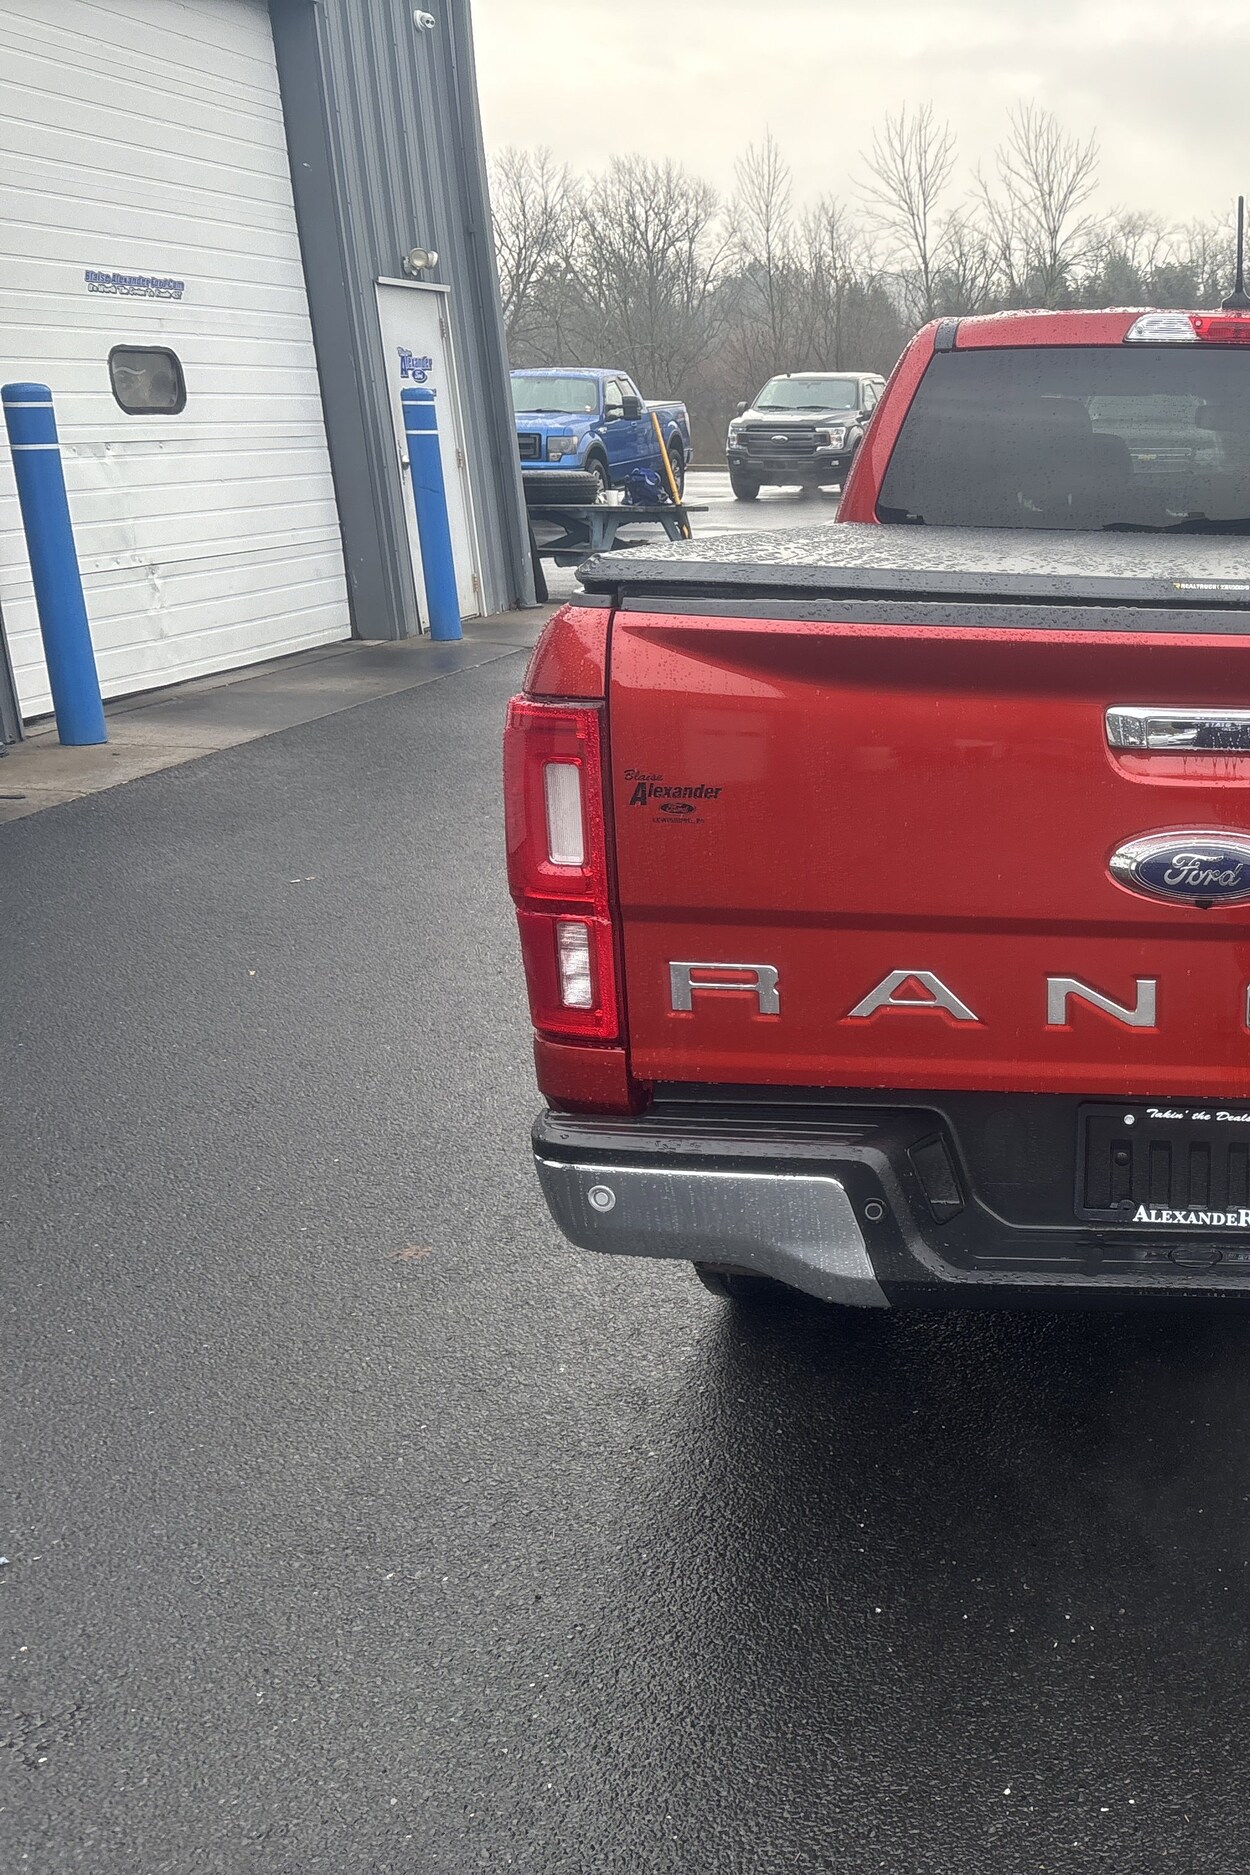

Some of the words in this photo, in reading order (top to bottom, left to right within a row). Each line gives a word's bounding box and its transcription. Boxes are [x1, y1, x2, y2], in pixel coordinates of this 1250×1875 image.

[624, 769, 663, 781] Blaise
[629, 782, 722, 806] Alexander
[1164, 854, 1244, 886] Ford
[1146, 1108, 1189, 1120] Takin'
[1192, 1110, 1211, 1121] the
